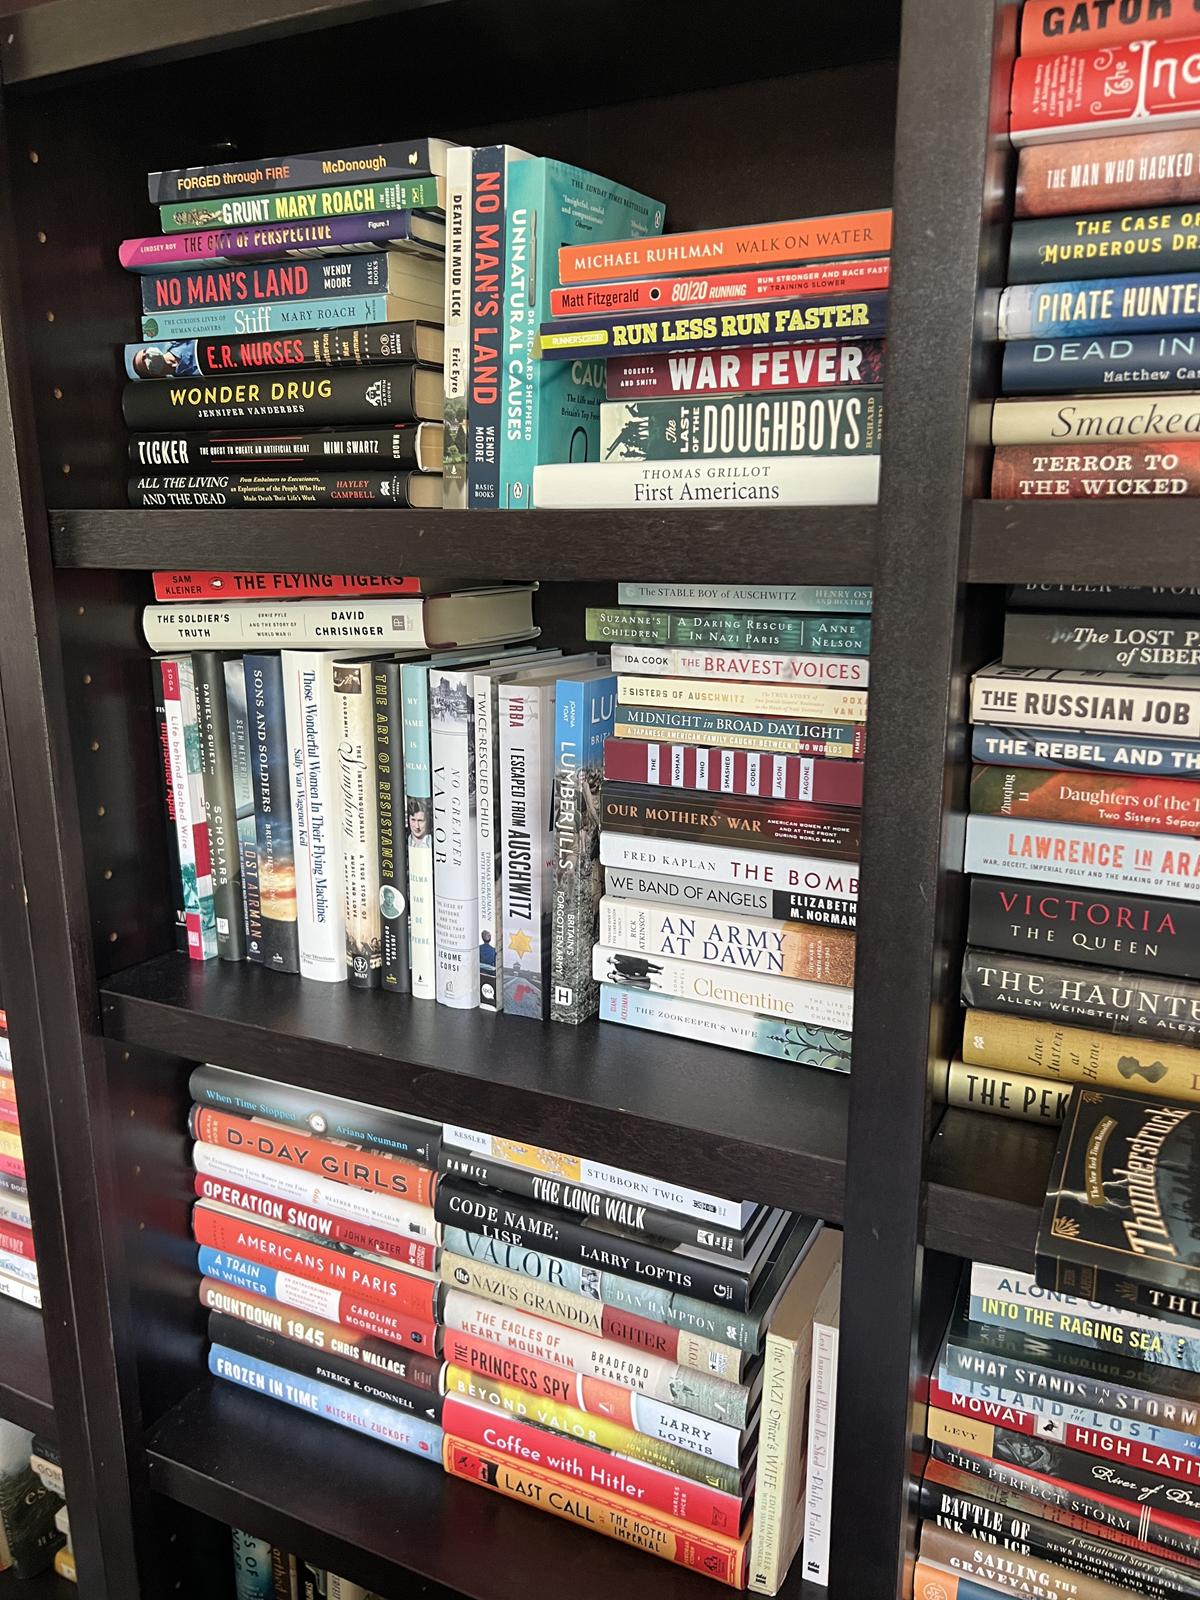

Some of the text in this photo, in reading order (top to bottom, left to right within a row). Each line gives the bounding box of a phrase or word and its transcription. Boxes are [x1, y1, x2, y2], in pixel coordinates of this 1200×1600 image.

[177, 167, 289, 189] FORGED through FIRE
[322, 156, 386, 174] McDonough
[1048, 153, 1193, 189] THE MAN WHO HACKED
[222, 188, 375, 224] GRUNT MARY ROACH
[736, 228, 873, 254] WALK ON WATER
[451, 195, 462, 317] DEATH IN MUD LICK
[574, 242, 723, 270] MICHAEL RUHLMAN
[323, 264, 352, 277] WENDY
[324, 276, 351, 289] MOORE
[757, 276, 774, 284] RUN
[776, 272, 819, 282] STRONGER
[822, 270, 840, 278] AND
[842, 268, 865, 277] RACE
[156, 265, 308, 306] NO MAN'S LAND
[562, 289, 639, 307] Matt Fitzgerald
[671, 281, 747, 301] 80/20 RUNNING
[507, 209, 527, 441] UNNATURAL CAUSES
[613, 304, 869, 346] RUN LESS RUN FASTER
[207, 339, 305, 369] E.R. NURSES
[1033, 337, 1193, 362] DEAD IN
[623, 367, 654, 375] ROBERTS
[668, 347, 863, 391] WAR FEVER
[1104, 371, 1169, 382] Matthew
[170, 379, 332, 406] WONDER DRUG
[620, 378, 657, 387] AND SMITH
[198, 404, 305, 418] JENNIFER VANDERBES
[703, 398, 861, 454] DOUGHBOYS
[138, 440, 189, 465] TICKER
[324, 440, 379, 454] MIMI SWARTZ
[643, 466, 771, 479] THOMAS GRILLOT
[1033, 454, 1178, 471] TERROR TO
[634, 482, 779, 502] First Americans
[1019, 479, 1187, 495] THE WICKED
[166, 585, 202, 595] KLEINER
[172, 575, 192, 584] SAM
[157, 613, 230, 623] THE SOLDIER'S
[331, 610, 364, 621] DAVID
[600, 613, 661, 624] SUZANNE'S
[818, 624, 856, 633] ANNE
[178, 628, 211, 638] TRUTH
[315, 625, 383, 637] CHRISINGER
[602, 627, 659, 638] CHILDREN
[812, 637, 862, 648] NELSON
[642, 656, 668, 664] COOK
[681, 658, 860, 680] THE BRAVEST VOICES
[509, 698, 524, 728] VRBA
[982, 691, 1190, 725] THE RUSSIAN JOB
[628, 711, 844, 739] MIDNIGHT in BROAD DAYLIGHT
[558, 742, 575, 870] LUMBERJILLS
[1008, 833, 1152, 868] LAWRENCE IN
[610, 877, 767, 908] WE BAND OF ANGELS
[999, 892, 1176, 935] VICTORIA
[661, 916, 786, 951] AN ARMY
[1011, 925, 1158, 956] THE QUEEN
[661, 936, 785, 971] AT DAWN
[694, 978, 793, 1014] Clementine
[207, 1090, 297, 1121] When Time Stopped
[227, 1128, 309, 1164] D-DAY
[321, 1157, 408, 1193] GIRLS
[587, 1168, 684, 1203] STUBBORN TWIG
[203, 1181, 282, 1220] OPERATION
[287, 1209, 333, 1235] SNOW
[532, 1176, 646, 1230] THE LONG WALK
[238, 1233, 324, 1272] AMERICANS
[330, 1263, 346, 1279] IN
[352, 1272, 398, 1296] PARIS
[580, 1245, 692, 1287] LARRY LOFTIS
[206, 1290, 282, 1331] COUNTDOWN
[287, 1320, 325, 1347] 1945
[346, 1316, 403, 1341] MOOREHEAD
[351, 1304, 397, 1328] CAROLINE
[982, 1297, 1162, 1352] INTO THE RAGING SEA
[331, 1339, 406, 1377] CHRIS WALLACE
[217, 1359, 318, 1411] FROZEN IN TIME
[470, 1350, 570, 1400] PRINCESS SPY
[951, 1393, 1027, 1426] MOWAT
[660, 1415, 712, 1441] LARRY
[943, 1425, 978, 1441] LEVY
[658, 1430, 713, 1456] LOFTIS
[484, 1429, 645, 1499] Coffee with Hitler
